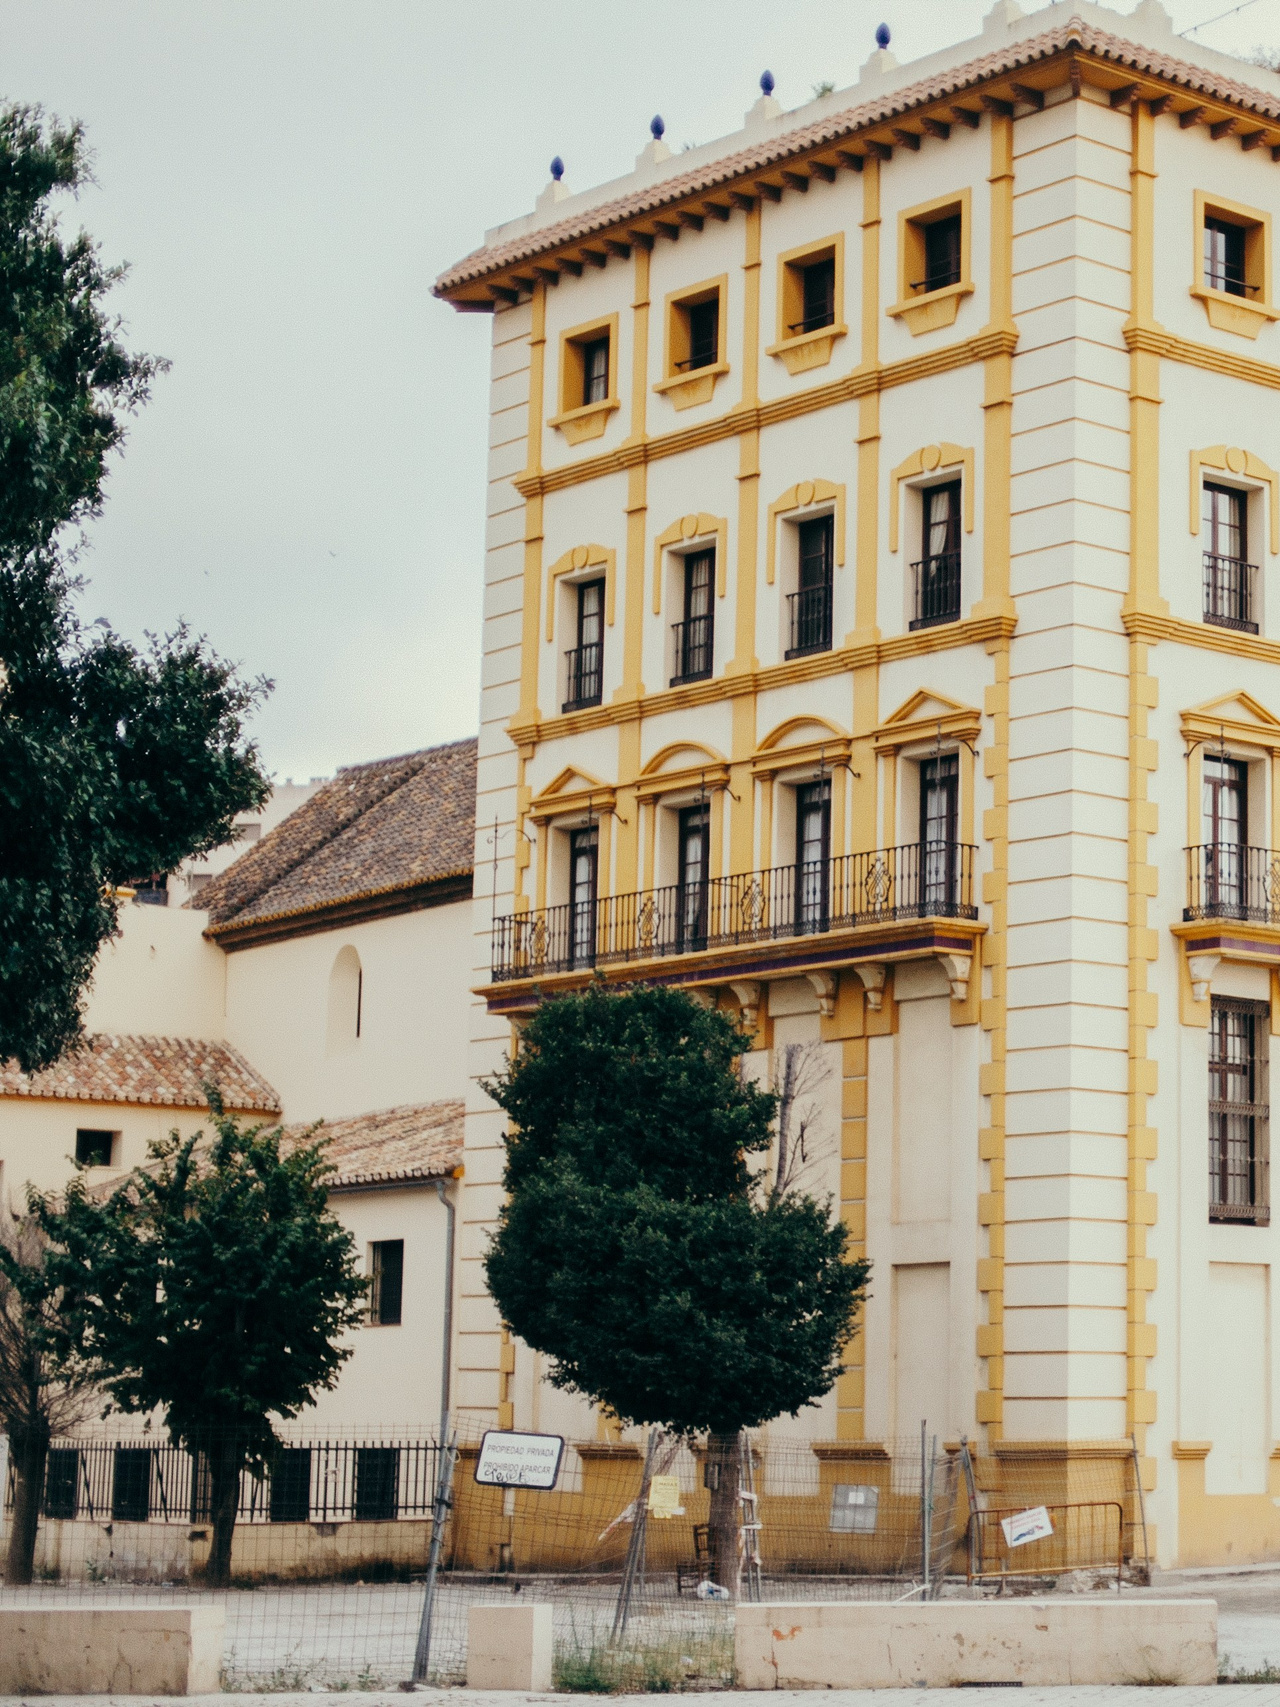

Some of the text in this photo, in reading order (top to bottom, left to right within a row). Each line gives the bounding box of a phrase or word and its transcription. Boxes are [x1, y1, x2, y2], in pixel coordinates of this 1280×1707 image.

[487, 1444, 554, 1457] PROPIEDAD PRIVADA
[483, 1461, 551, 1474] PROHIBIDO APARCAR
